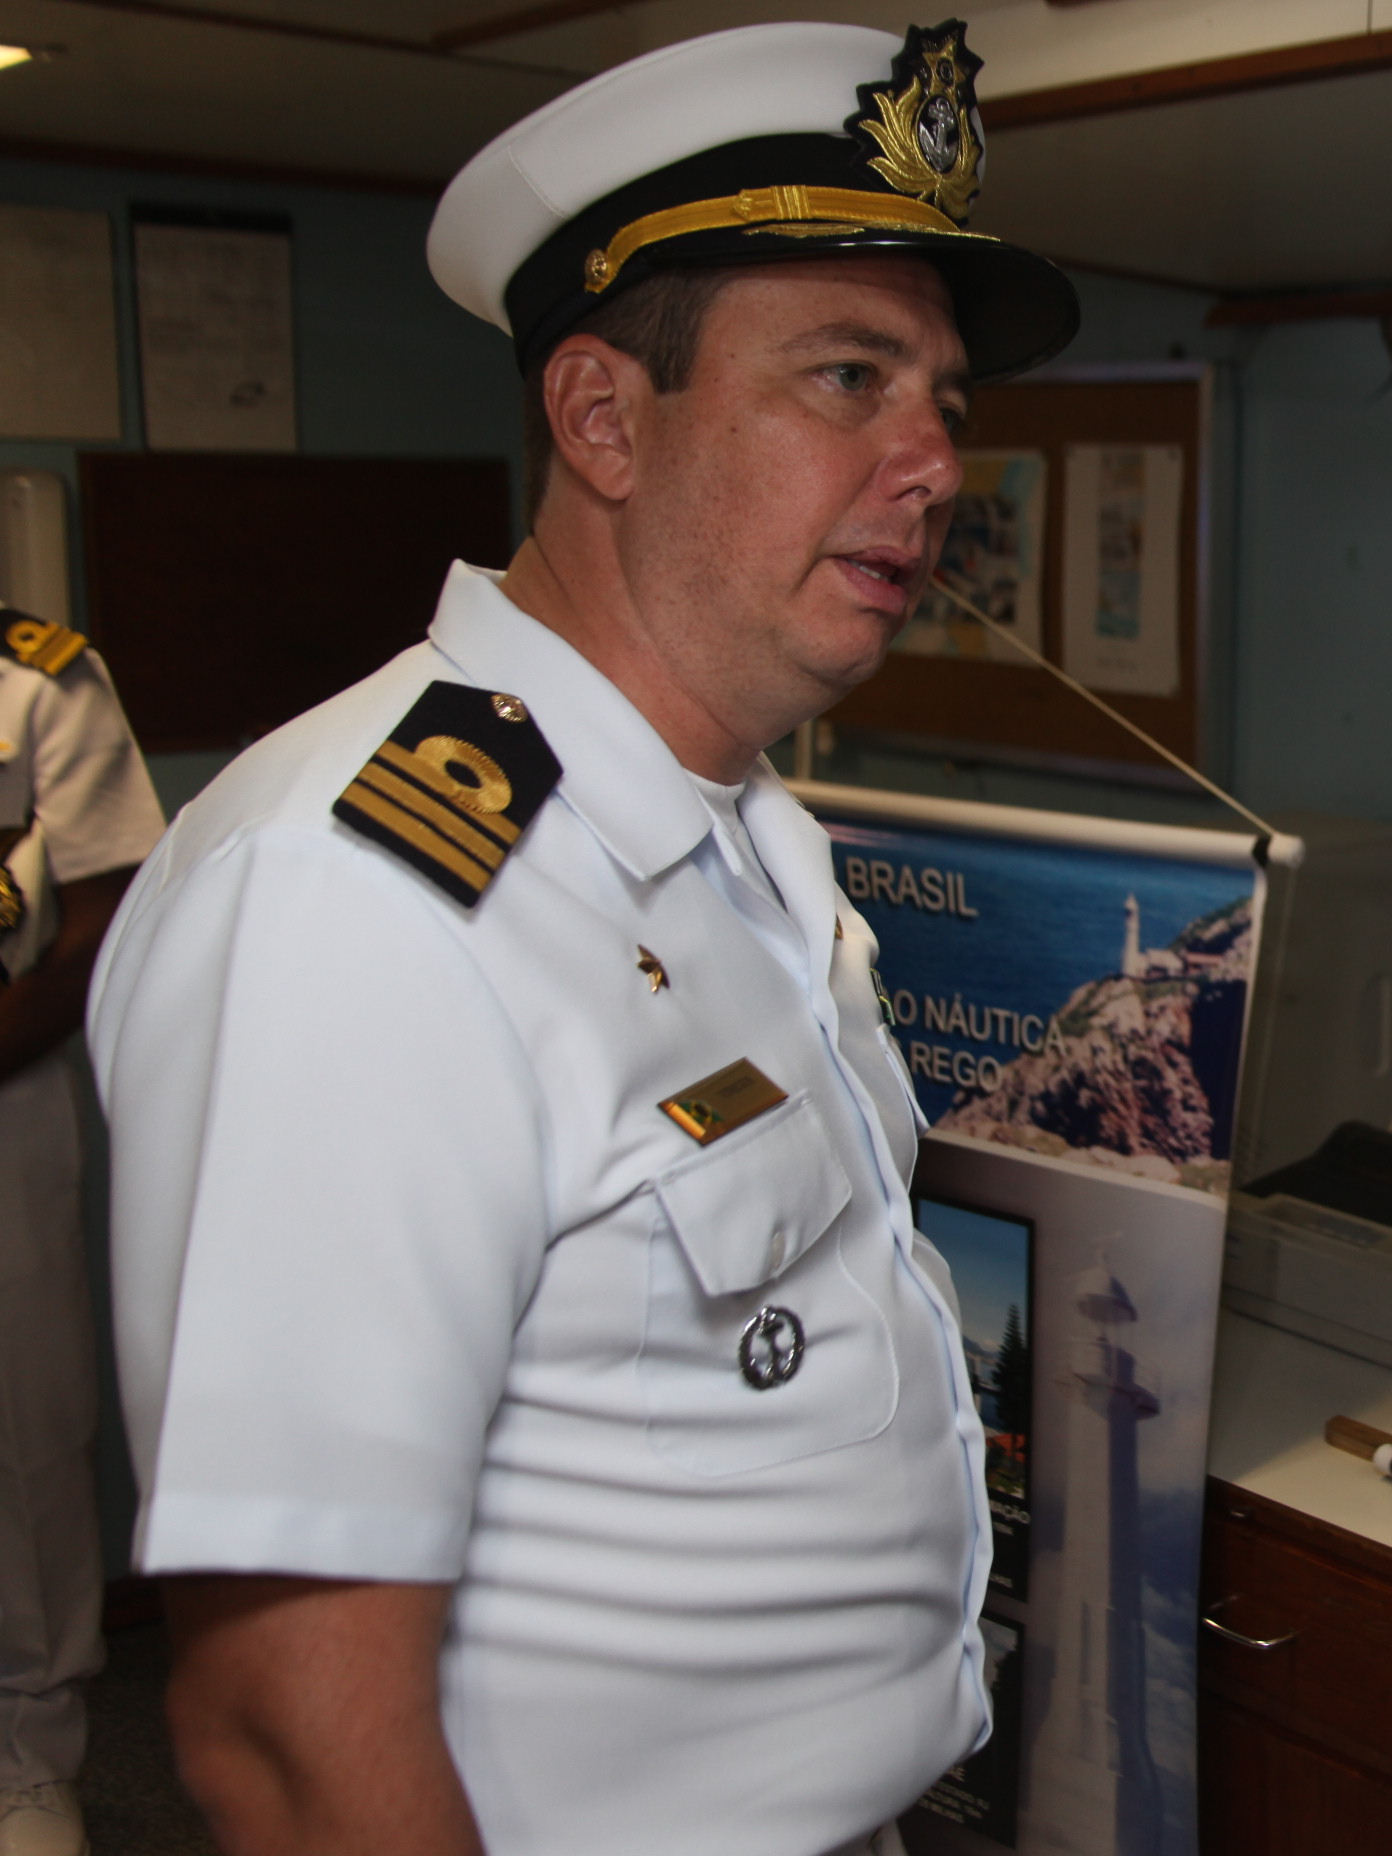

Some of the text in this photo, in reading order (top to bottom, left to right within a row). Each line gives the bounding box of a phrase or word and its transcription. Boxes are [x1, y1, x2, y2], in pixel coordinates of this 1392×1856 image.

[846, 856, 979, 917] BRASIL
[925, 992, 1069, 1056] NÁUTICA
[909, 1040, 1001, 1093] REGO
